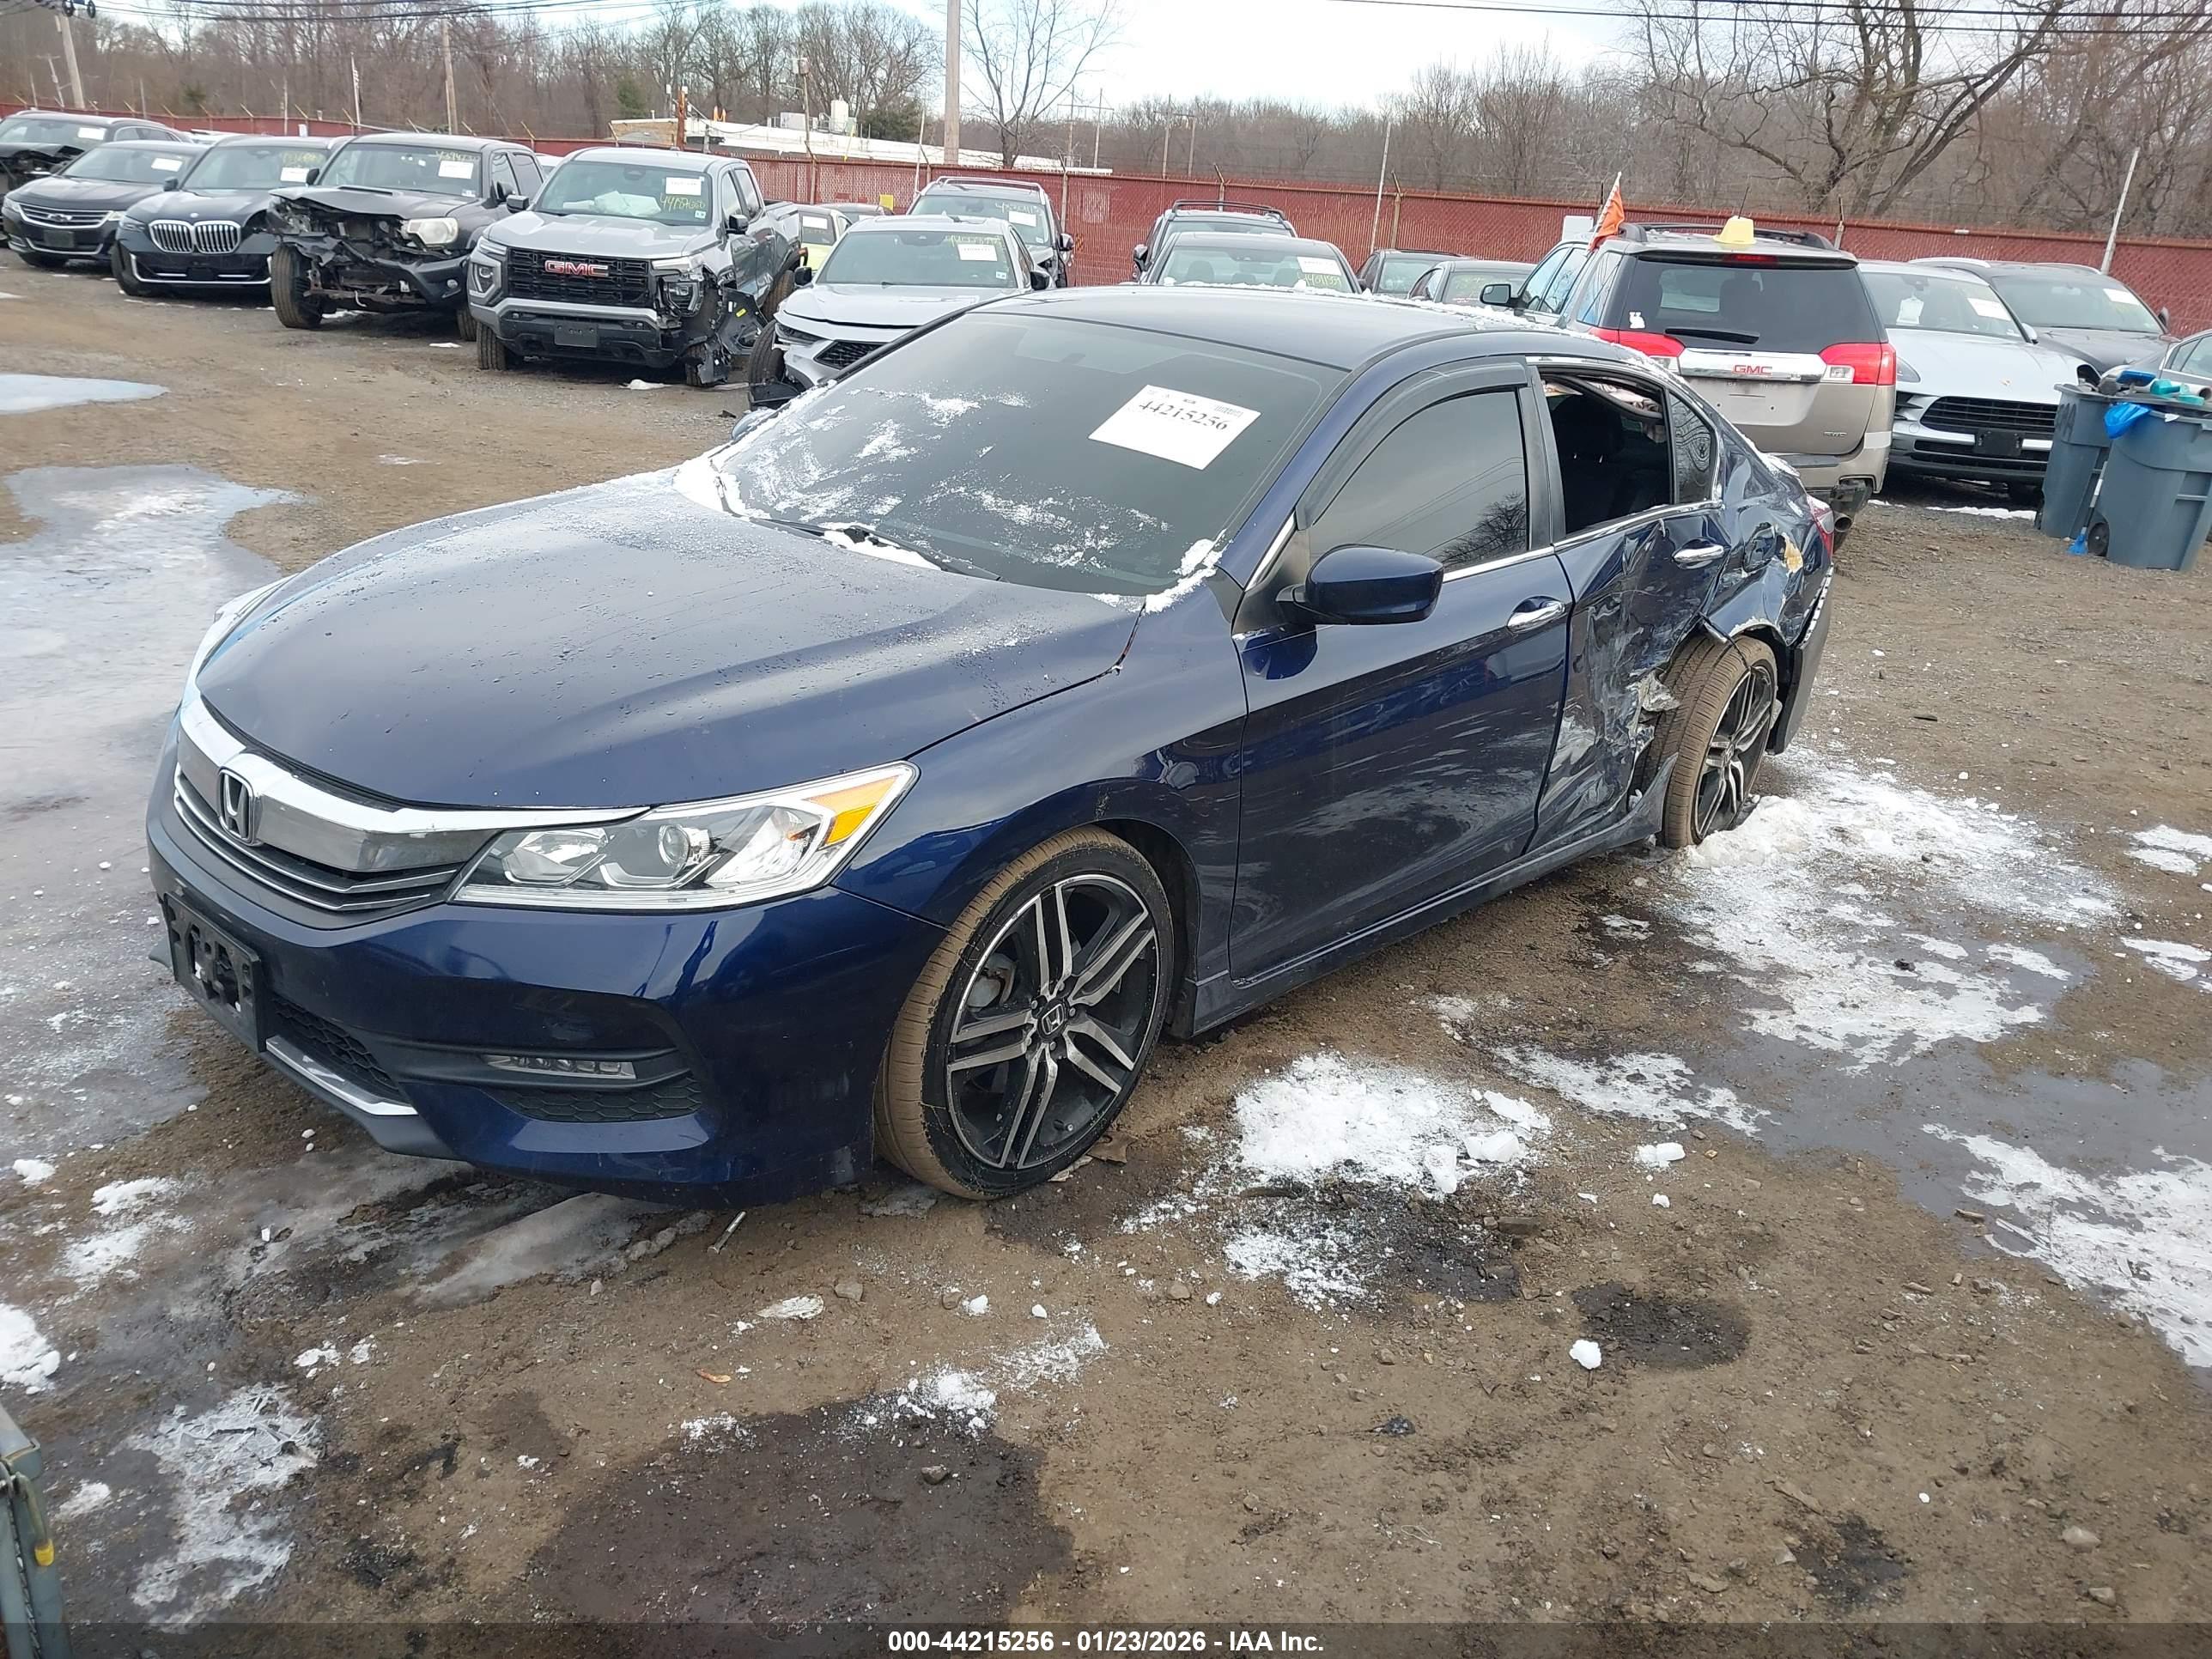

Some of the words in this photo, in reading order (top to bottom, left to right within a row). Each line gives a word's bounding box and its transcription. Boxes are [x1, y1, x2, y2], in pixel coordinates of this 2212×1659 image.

[544, 260, 609, 276] GMC
[1733, 364, 1772, 375] GMC
[1139, 400, 1230, 430] 44215256
